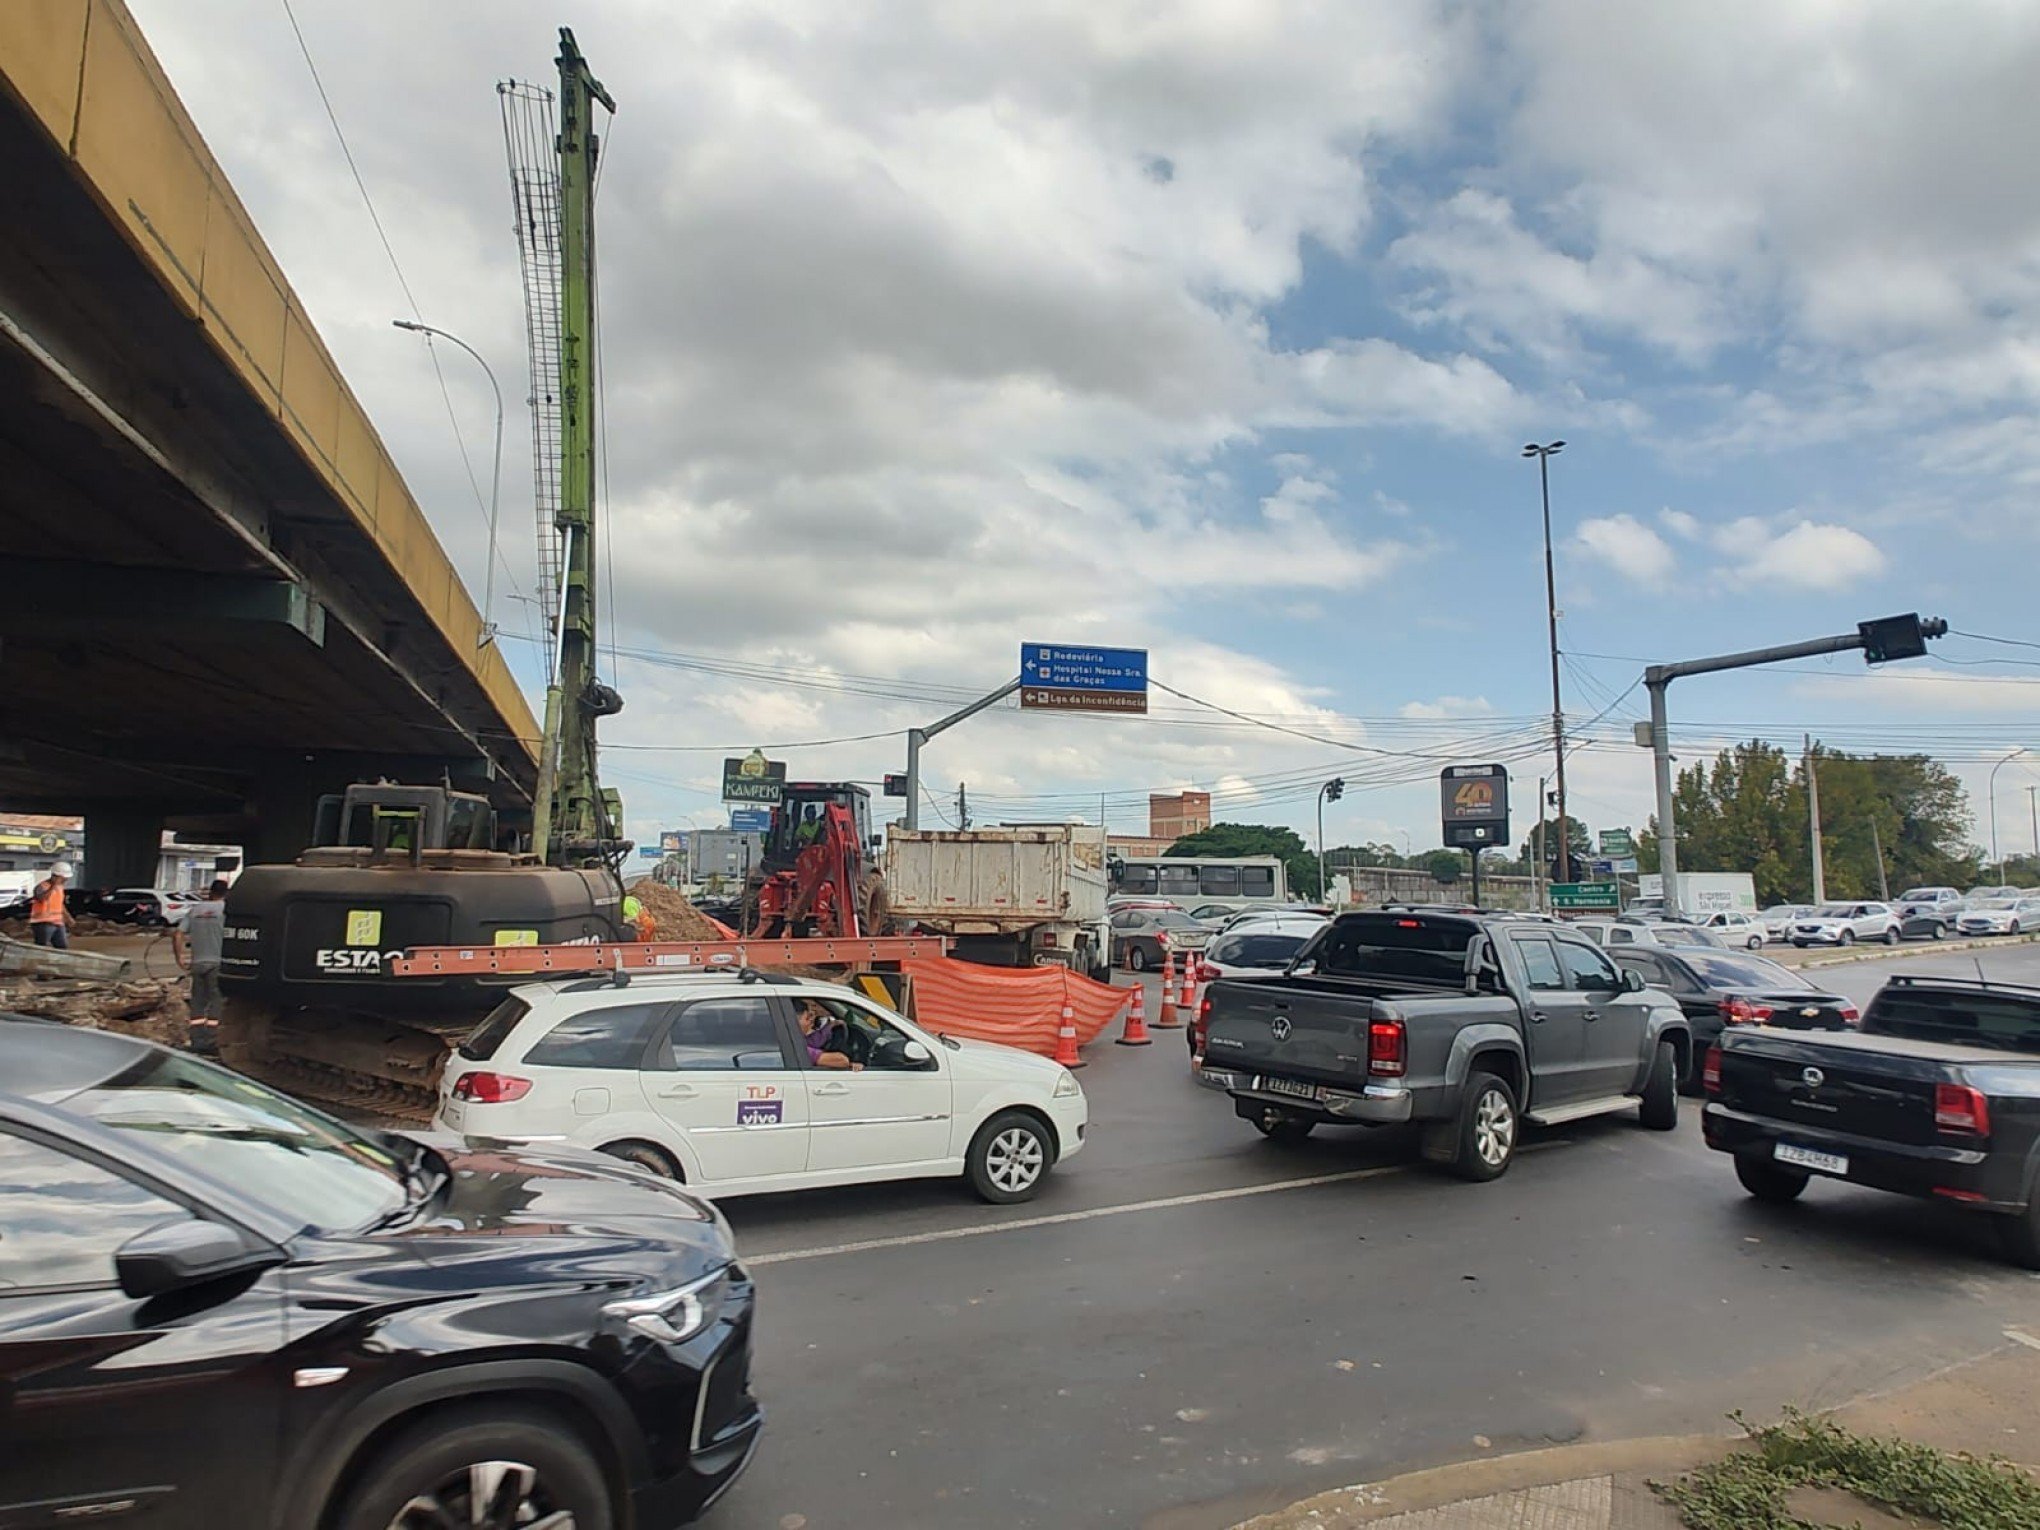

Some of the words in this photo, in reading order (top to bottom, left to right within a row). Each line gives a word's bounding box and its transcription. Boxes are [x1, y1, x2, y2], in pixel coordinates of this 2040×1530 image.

[1054, 665, 1092, 675] Hospital
[1095, 666, 1122, 677] Nossa
[1053, 674, 1070, 683] das
[1073, 675, 1105, 686] Graças
[746, 1086, 776, 1099] TLP
[742, 1110, 777, 1124] vivo
